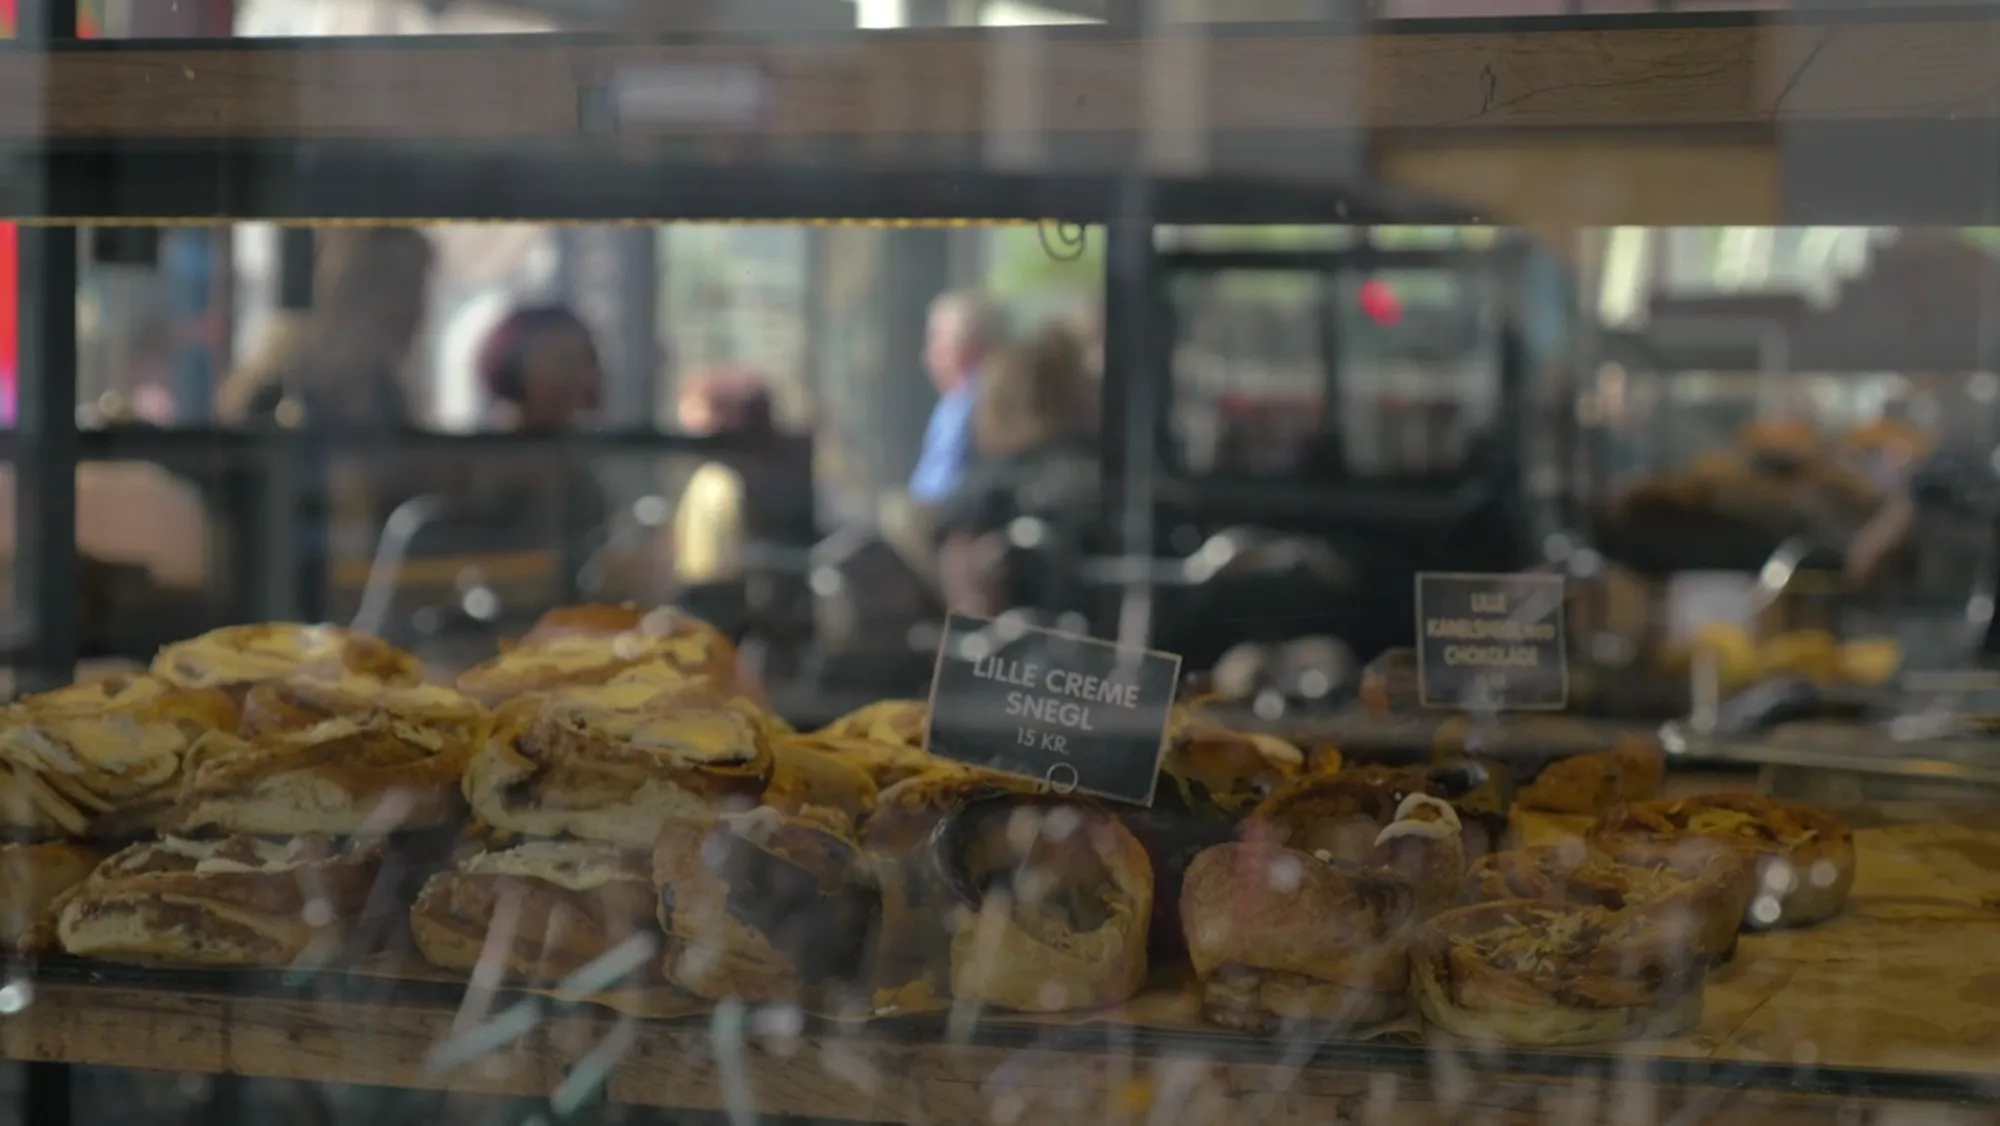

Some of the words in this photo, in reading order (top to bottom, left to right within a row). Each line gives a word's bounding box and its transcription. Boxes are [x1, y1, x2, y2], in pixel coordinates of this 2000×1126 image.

[972, 655, 1039, 688] LILLE
[1045, 668, 1141, 709] CREME
[1005, 691, 1094, 731] SNEGL
[1016, 727, 1036, 747] 15
